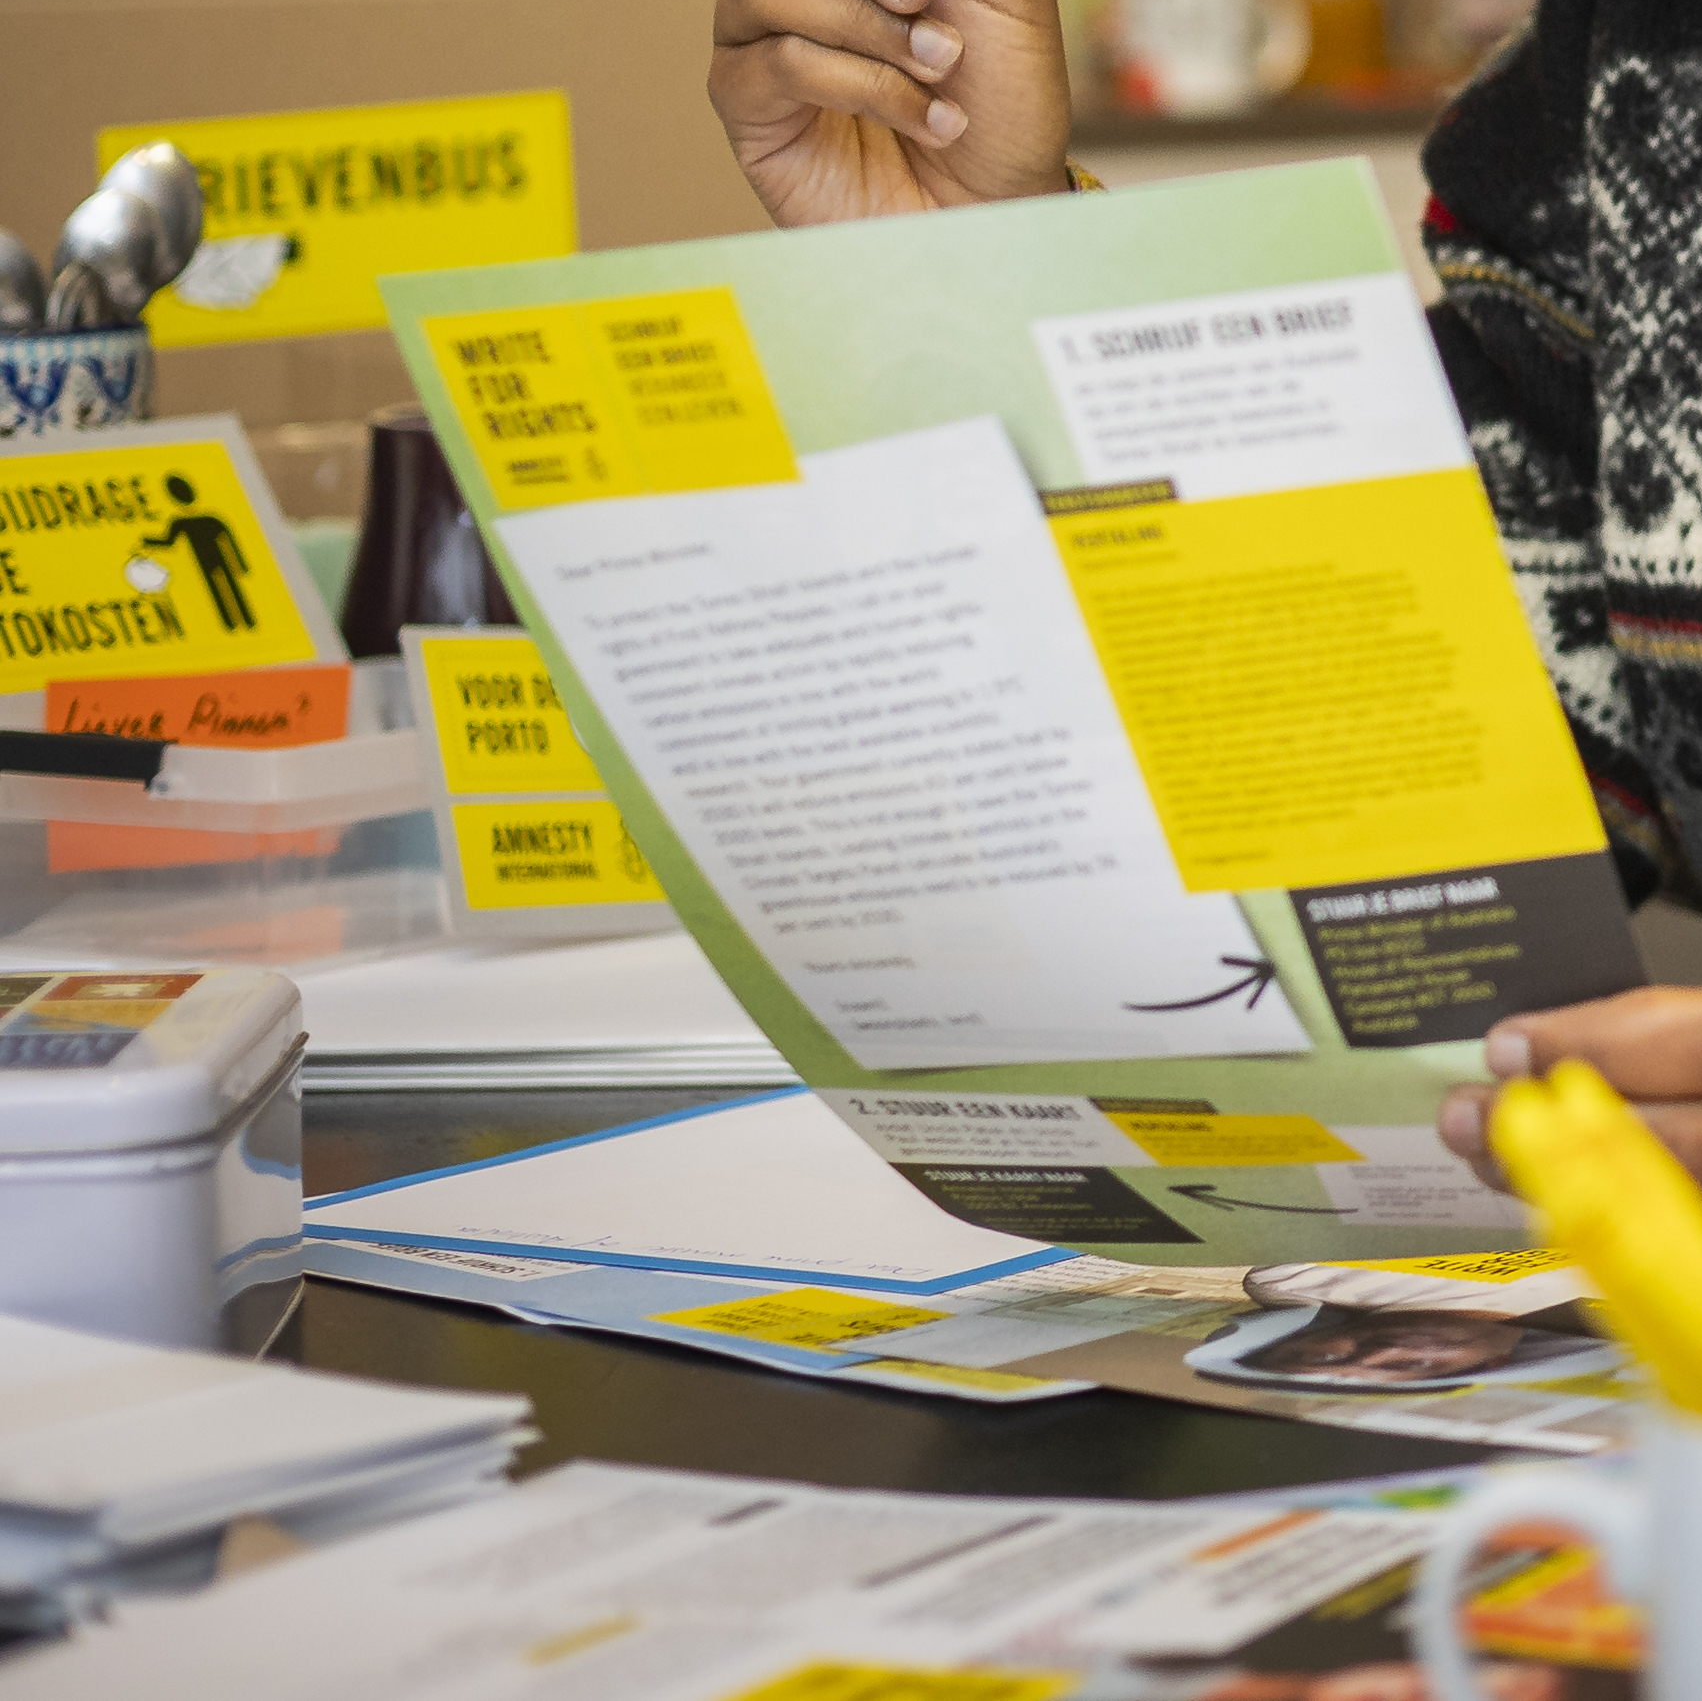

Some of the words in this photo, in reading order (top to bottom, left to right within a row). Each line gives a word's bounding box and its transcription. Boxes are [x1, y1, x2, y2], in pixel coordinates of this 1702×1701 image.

[192, 131, 530, 220] RIEVENBUS
[450, 328, 552, 367] WRITE
[465, 370, 534, 406] FOR
[481, 399, 599, 440] RIGHTS
[0, 474, 160, 535] IJDRAGE
[0, 548, 30, 597] E
[455, 672, 526, 709] VOOR
[465, 719, 549, 755] PORTO
[492, 819, 593, 855] AMNESTY
[876, 1099, 952, 1117] STUUR
[954, 1100, 1006, 1119] EEN
[1008, 1104, 1082, 1121] KAART
